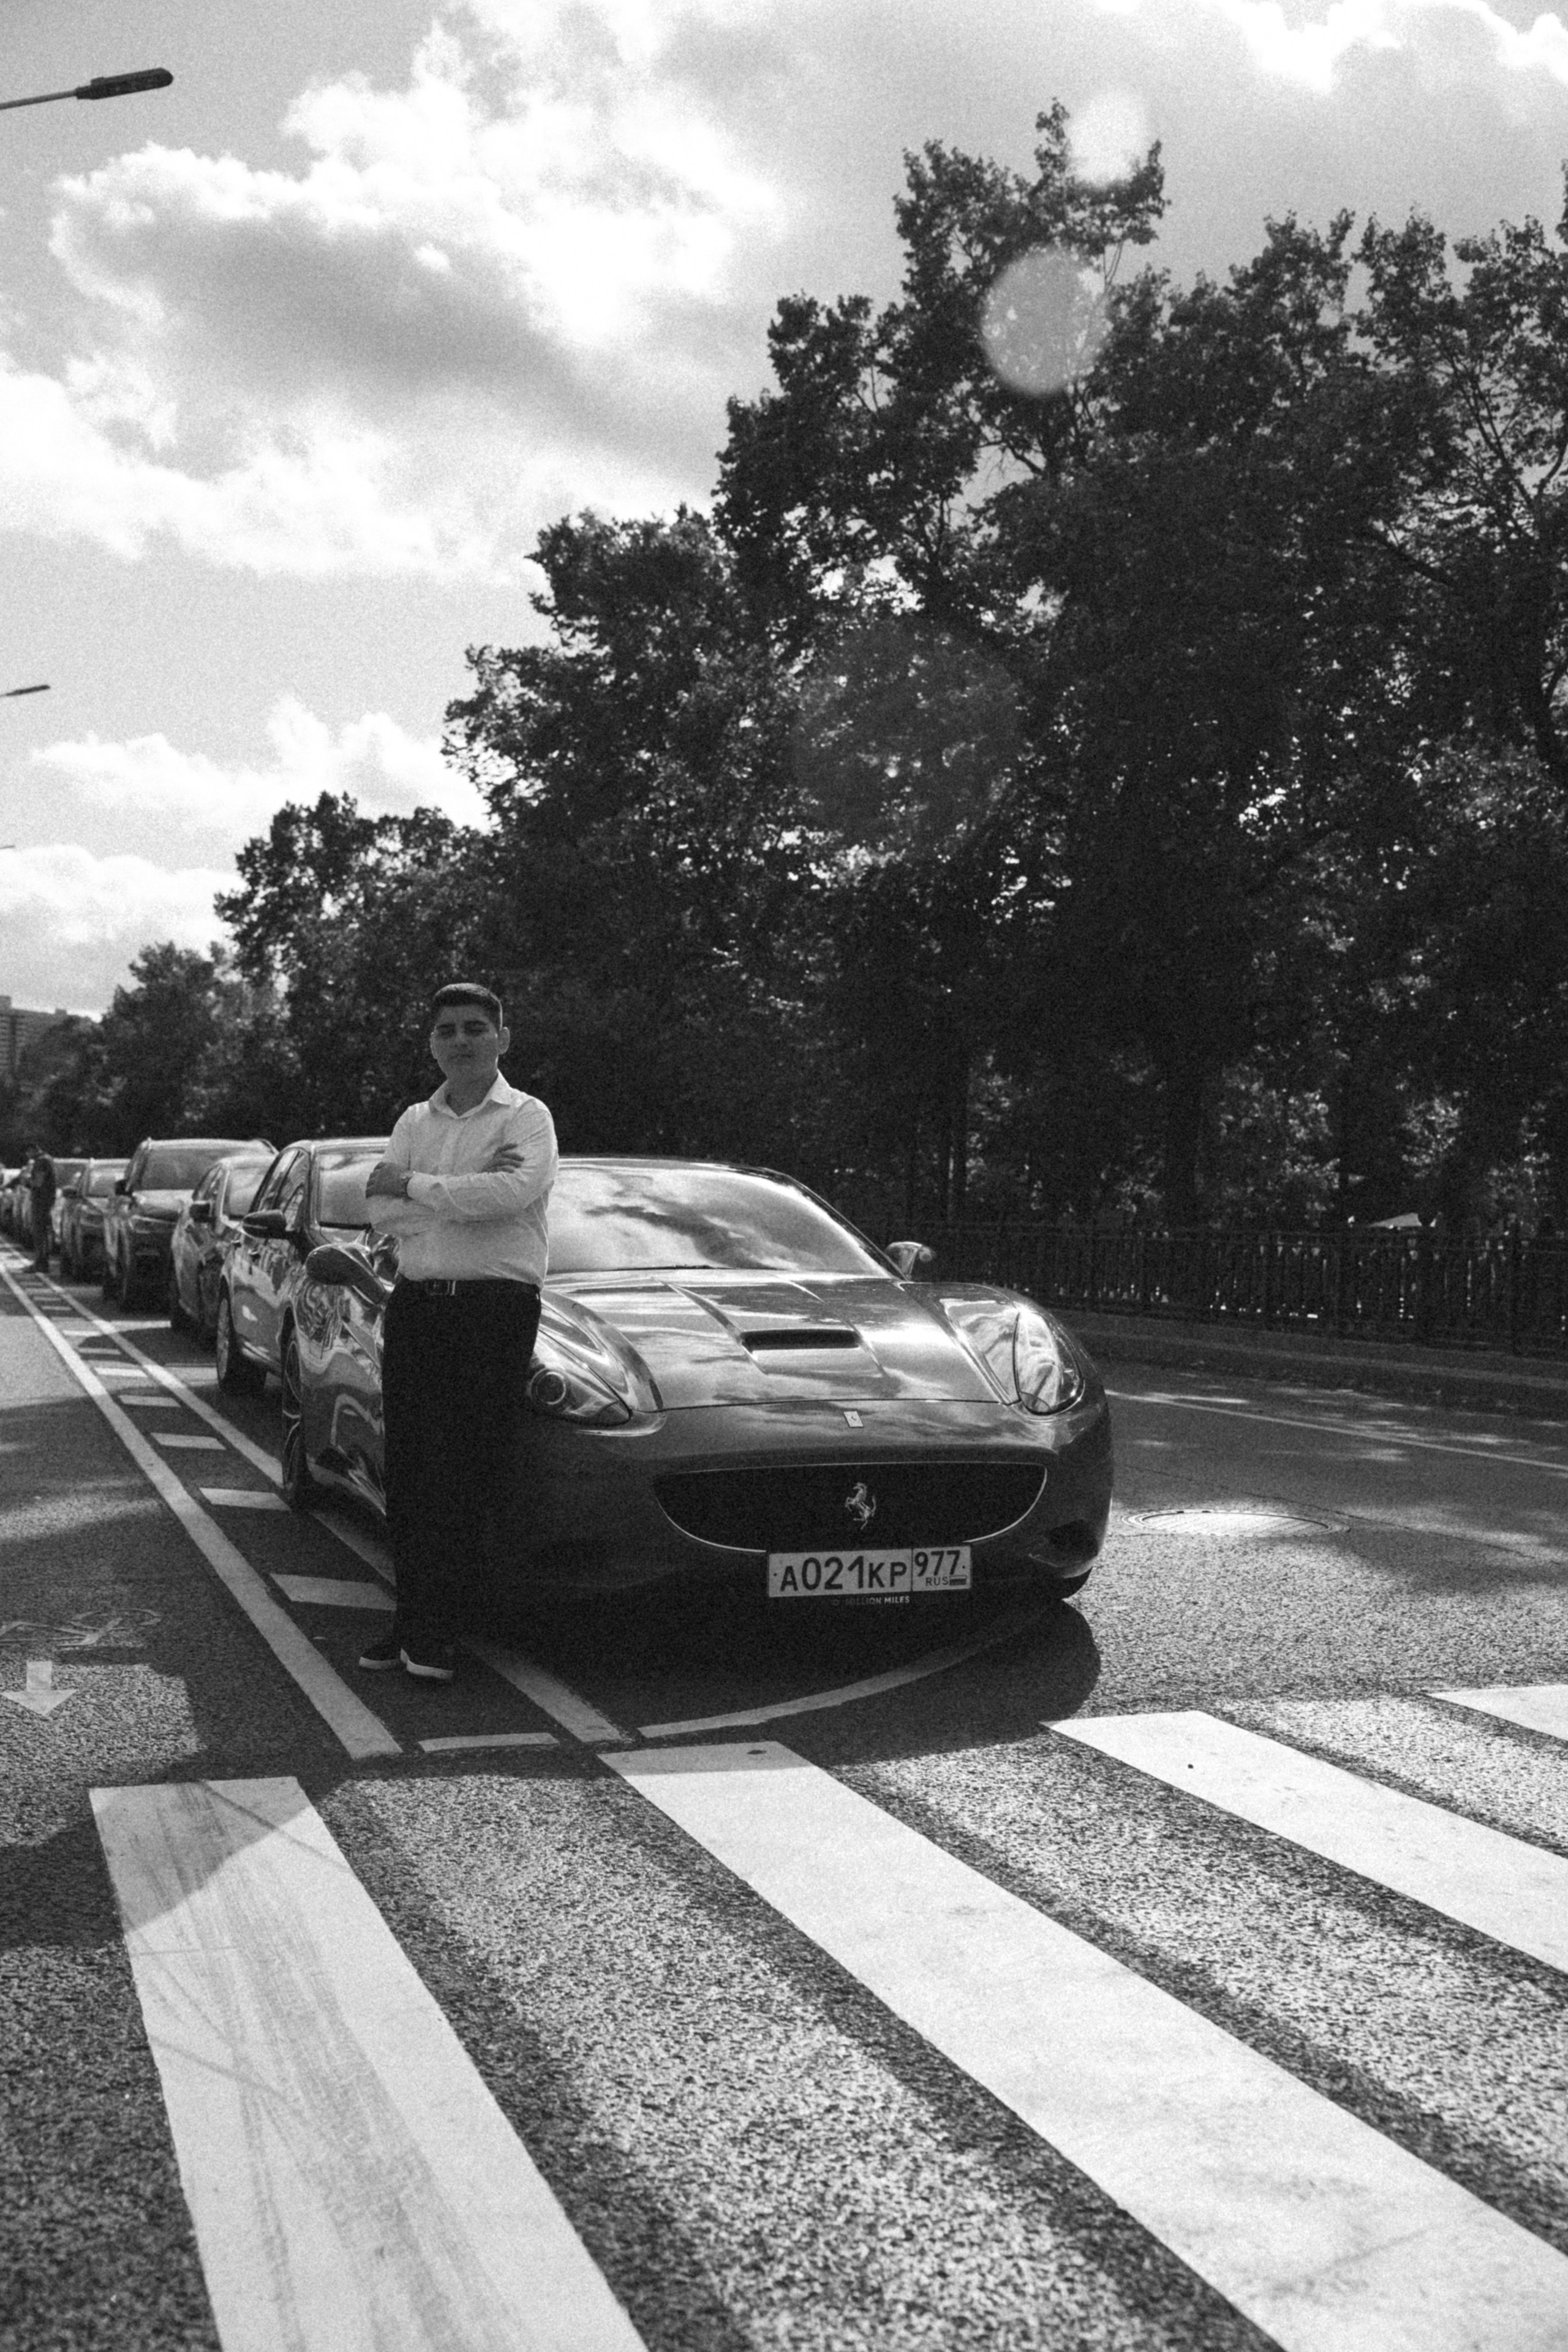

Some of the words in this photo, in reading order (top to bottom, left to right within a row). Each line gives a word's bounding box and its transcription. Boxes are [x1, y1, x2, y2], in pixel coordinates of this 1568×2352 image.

[914, 1550, 960, 1577] 977
[925, 1577, 949, 1586] RUS
[884, 1596, 910, 1604] MILES
